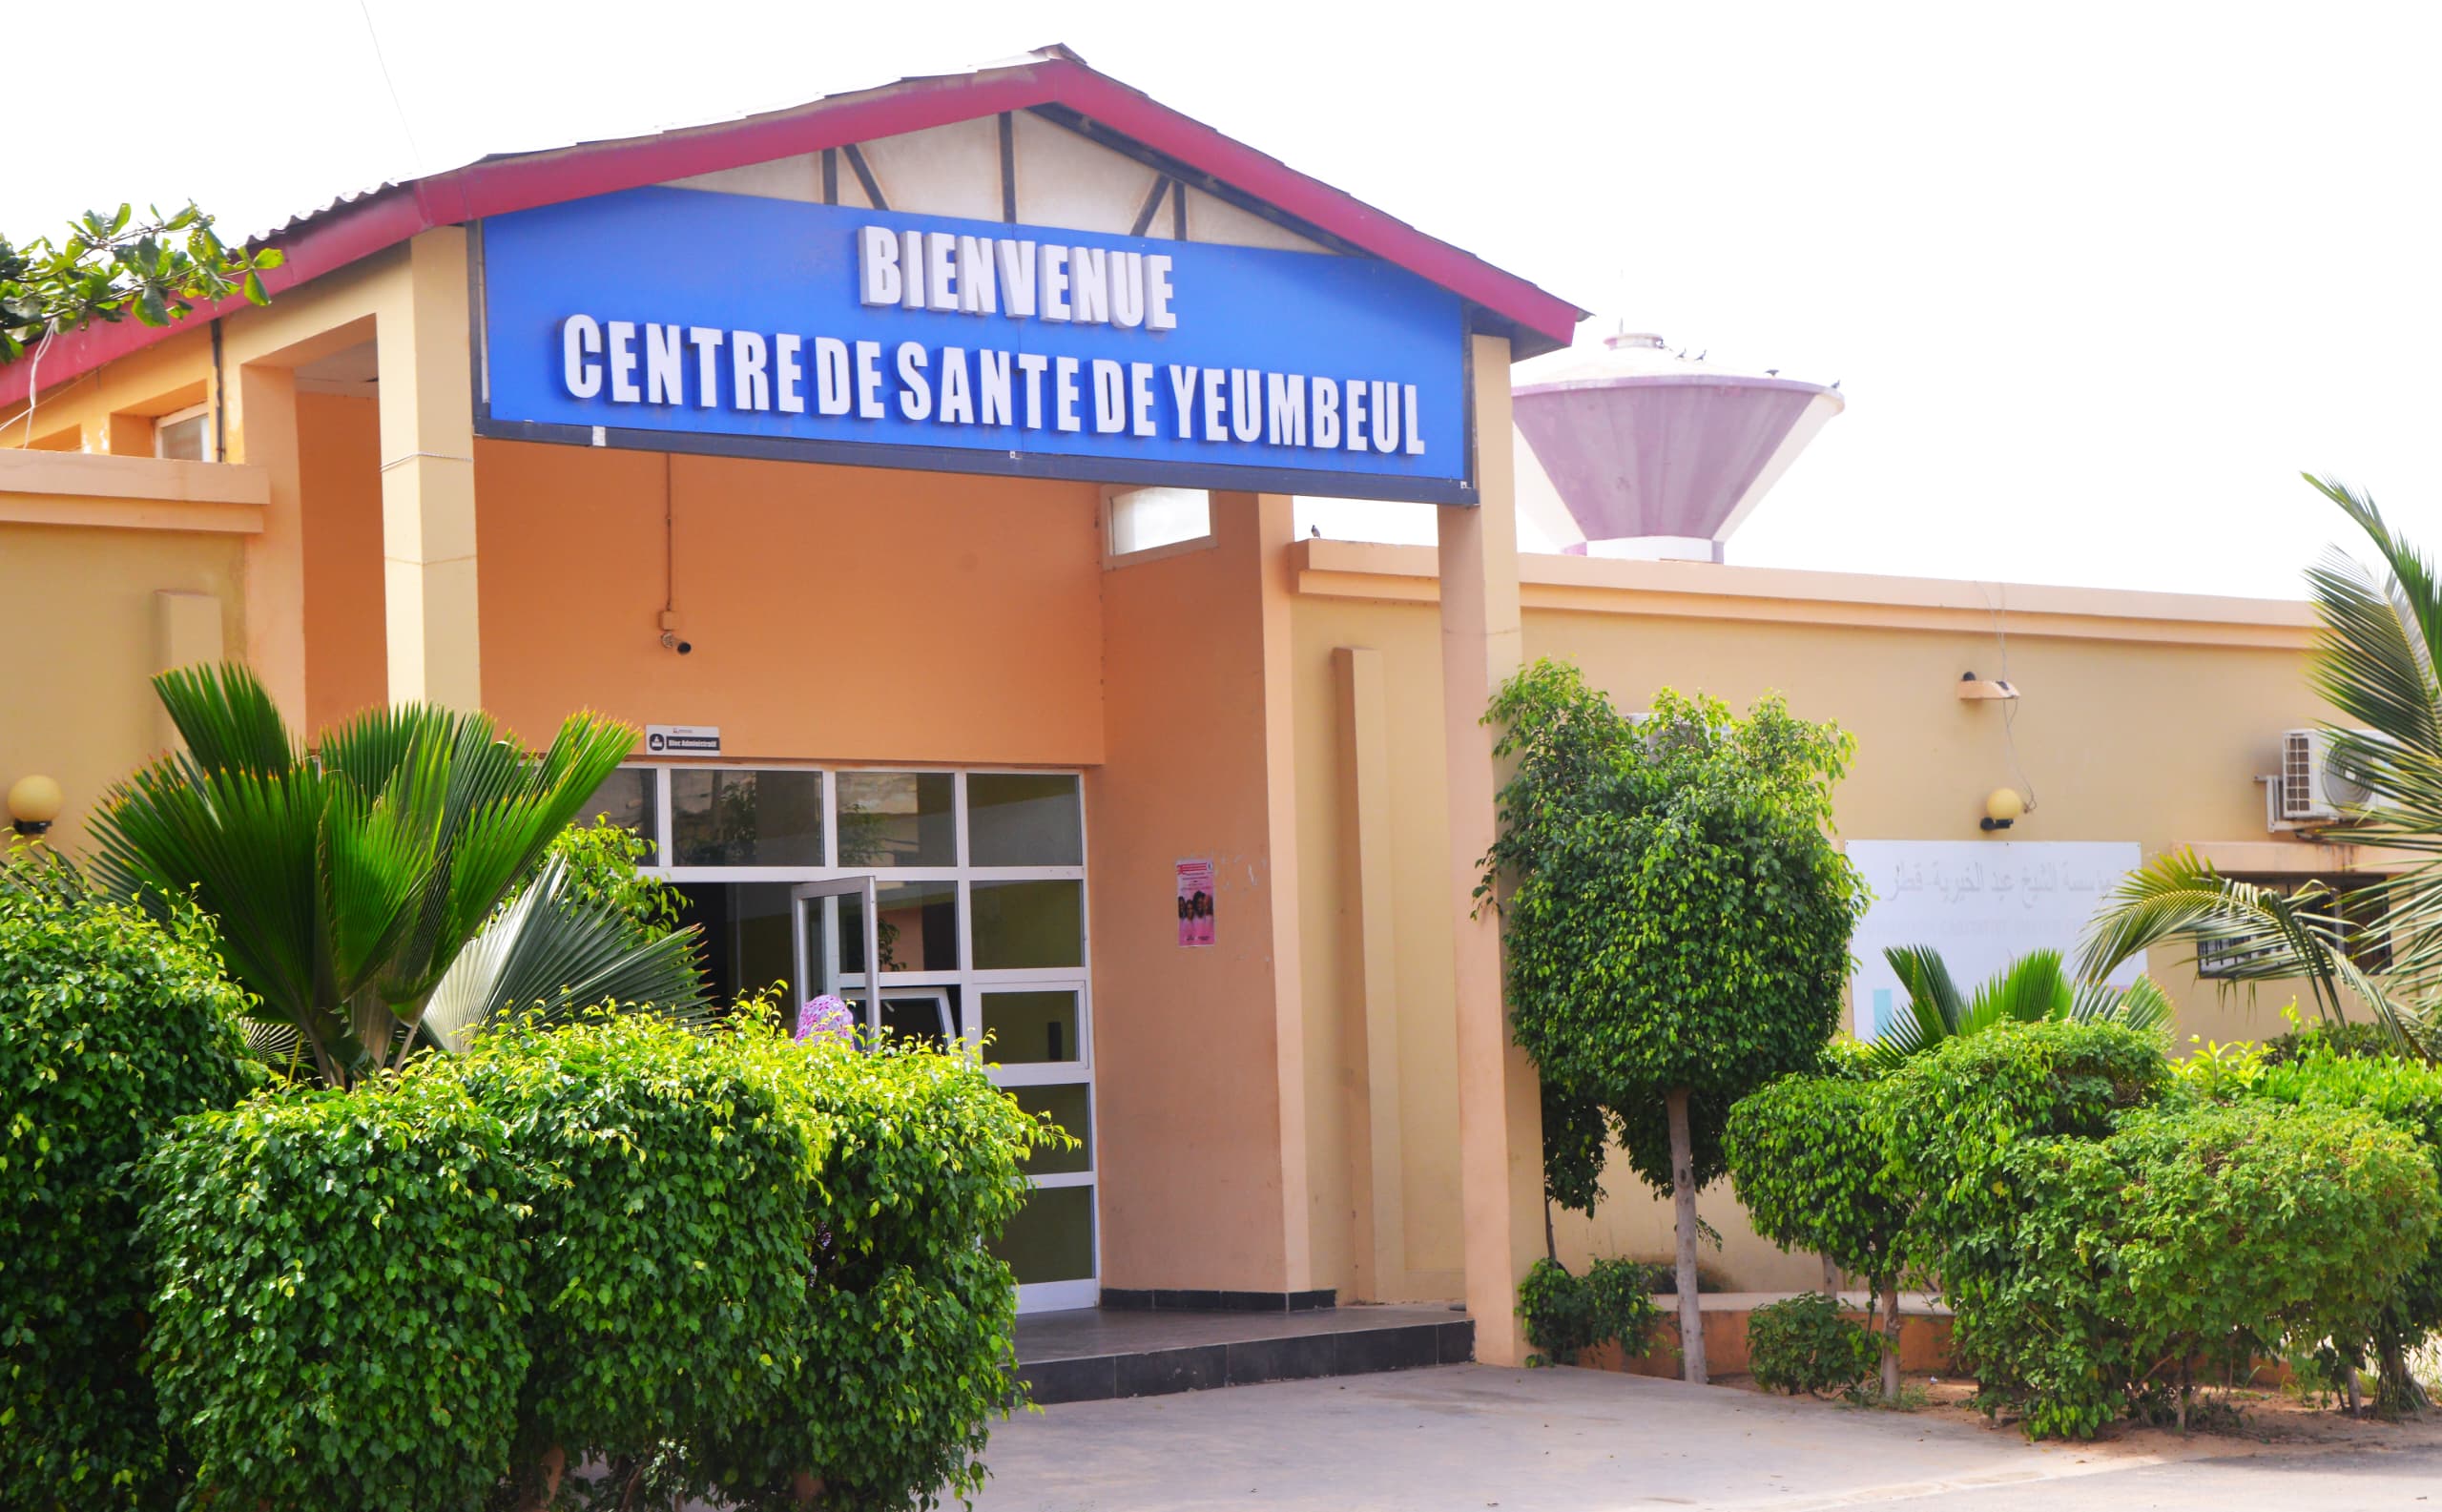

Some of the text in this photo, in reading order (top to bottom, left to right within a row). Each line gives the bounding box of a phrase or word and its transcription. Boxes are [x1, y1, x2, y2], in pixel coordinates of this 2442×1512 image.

[859, 224, 1178, 332] BIENVENUE
[562, 313, 1426, 456] CENTRE DE SANTE DE YEUMBEUL
